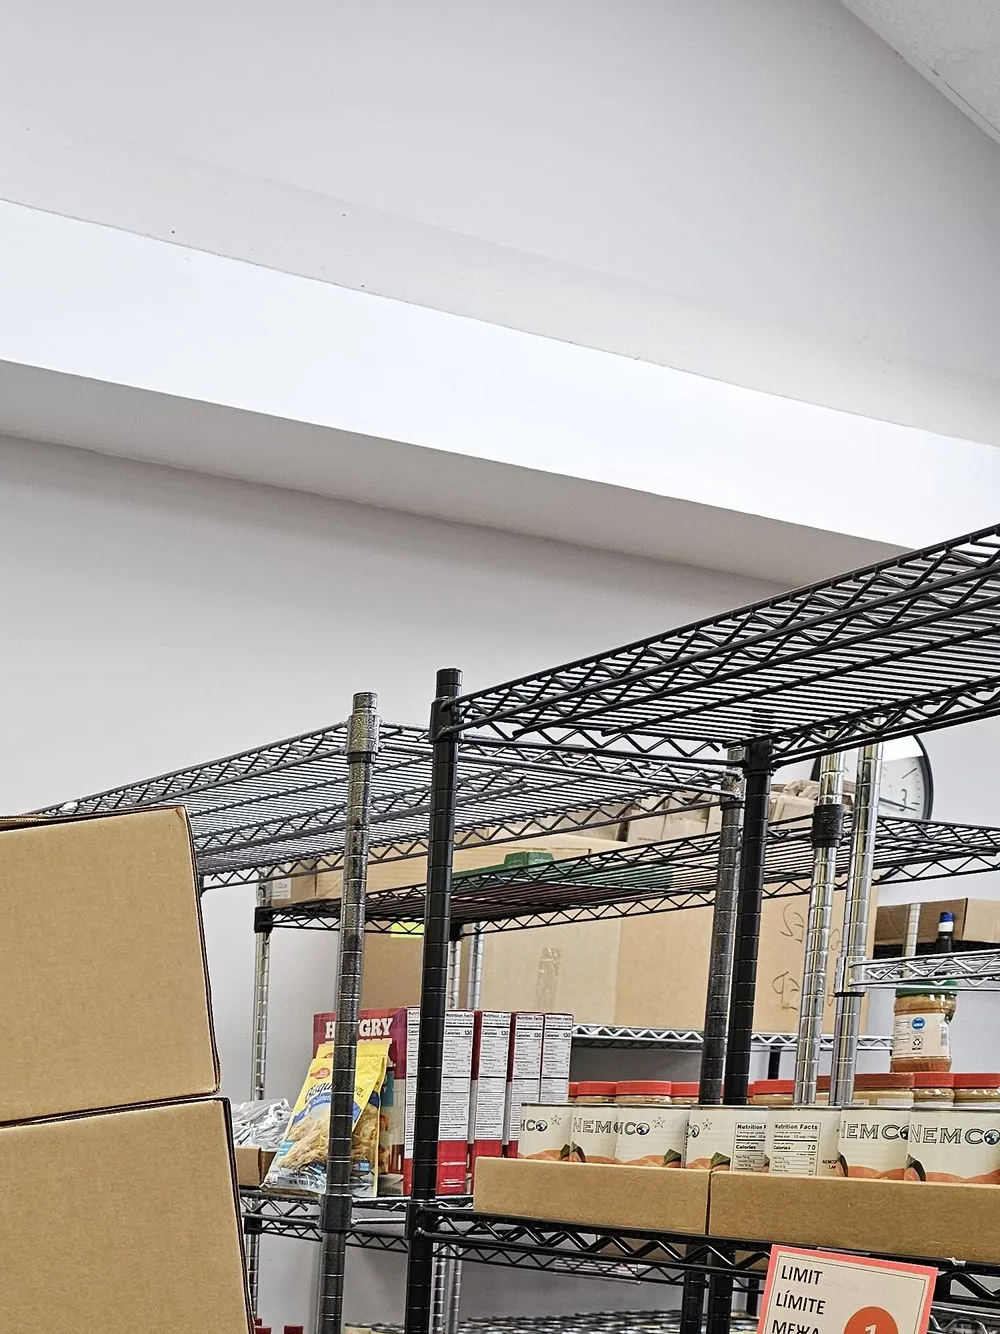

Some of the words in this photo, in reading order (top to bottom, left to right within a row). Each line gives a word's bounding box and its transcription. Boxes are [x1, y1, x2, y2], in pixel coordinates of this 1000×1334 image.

[325, 1018, 393, 1039] HGRY
[781, 1265, 823, 1285] LIMIT
[775, 1289, 826, 1315] LÍMITE
